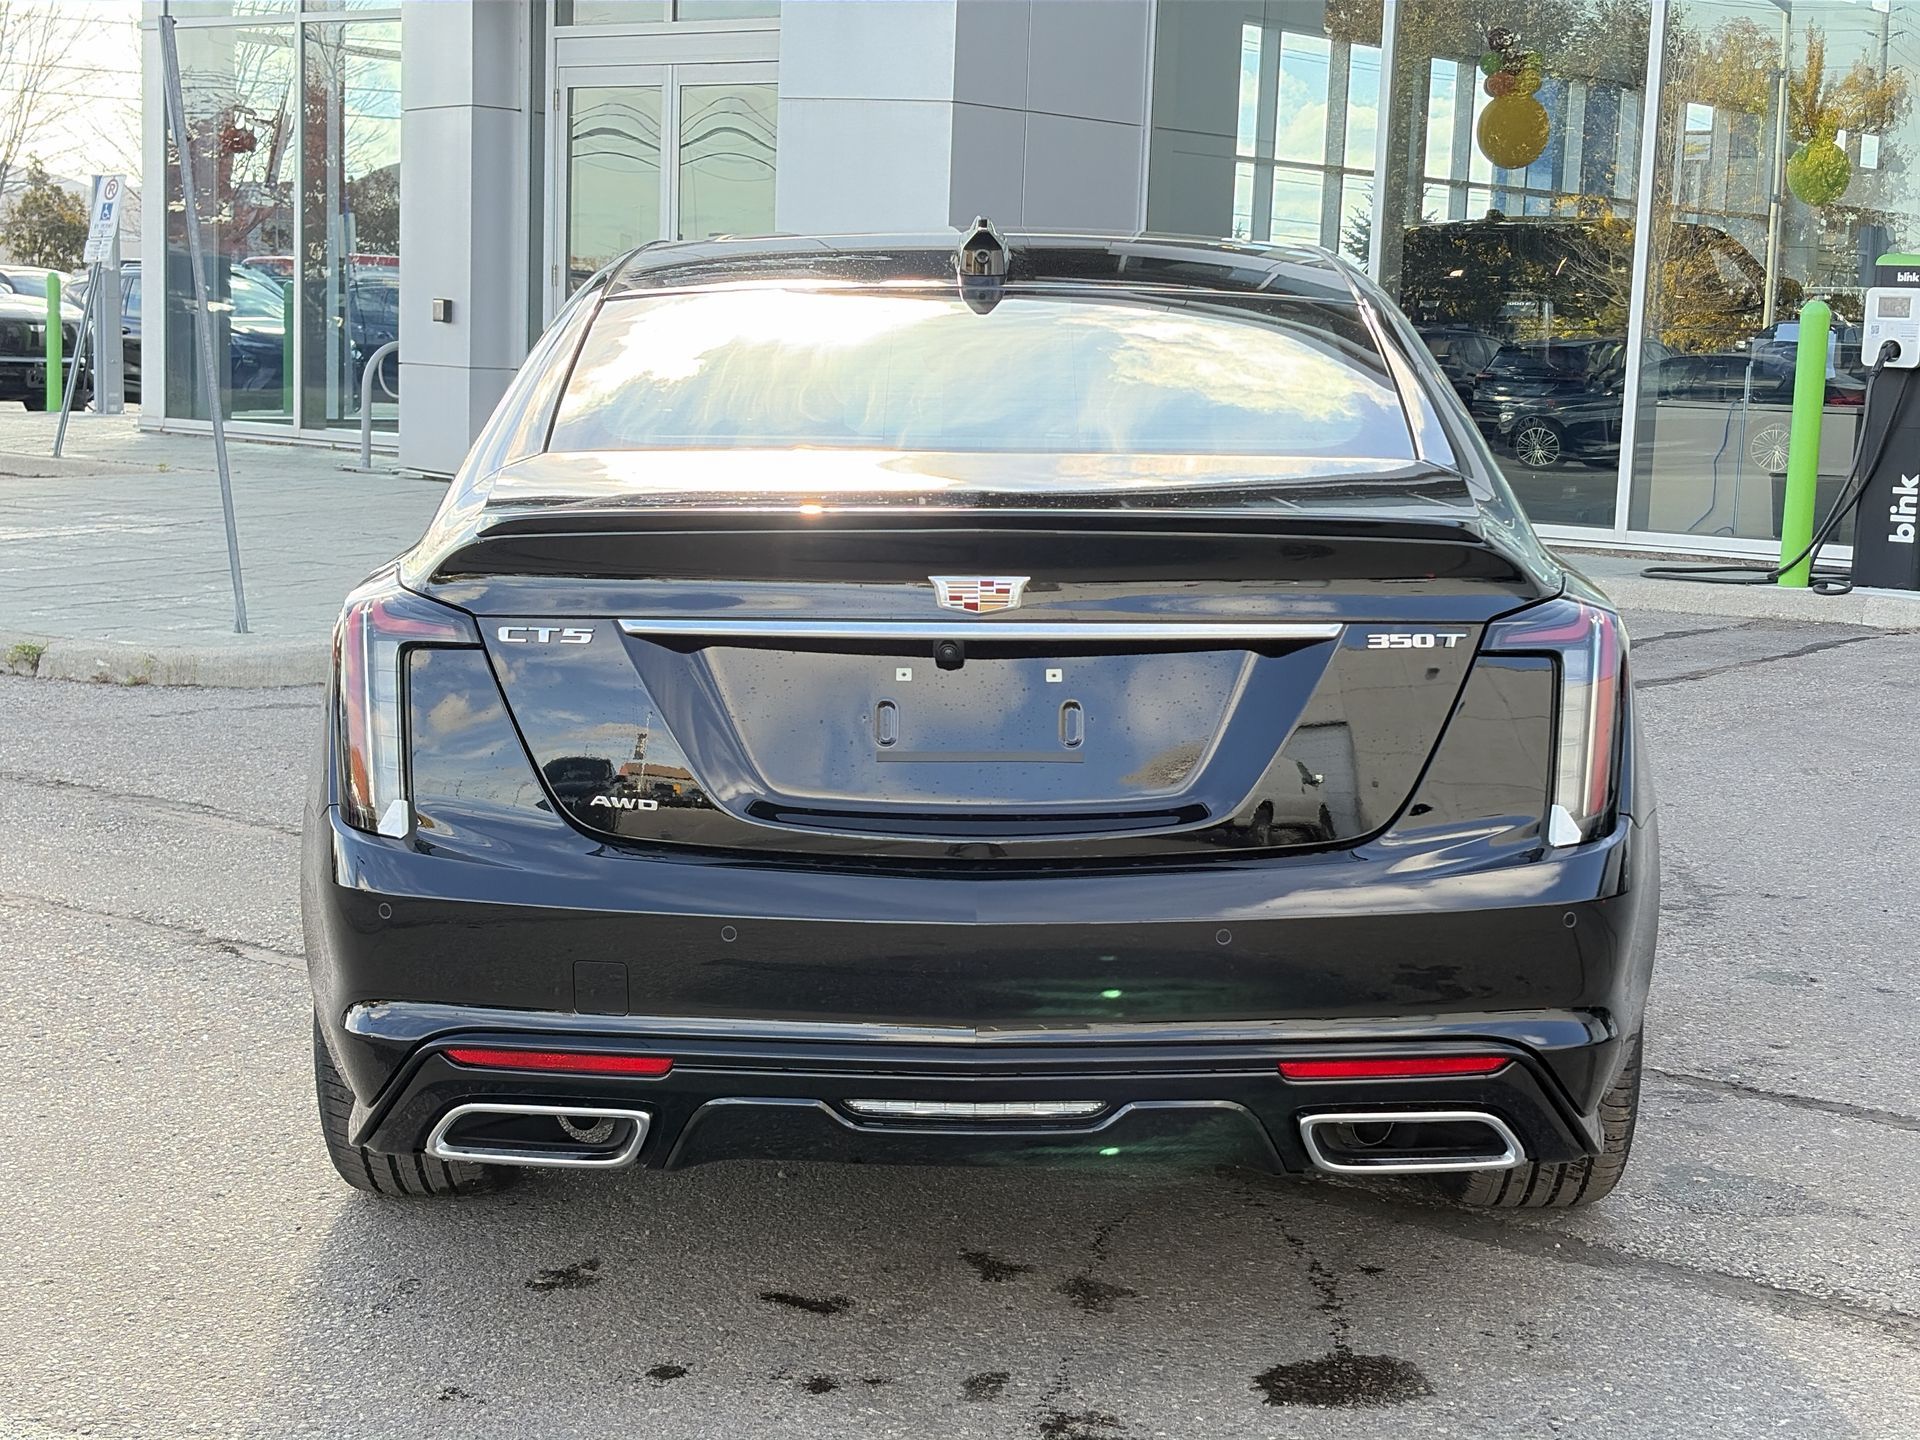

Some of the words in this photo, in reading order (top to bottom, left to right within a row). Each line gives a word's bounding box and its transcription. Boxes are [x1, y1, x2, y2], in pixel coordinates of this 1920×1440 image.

[1897, 272, 1920, 282] blink
[1888, 474, 1920, 543] blink
[498, 627, 594, 643] CT5
[590, 795, 658, 811] AWD
